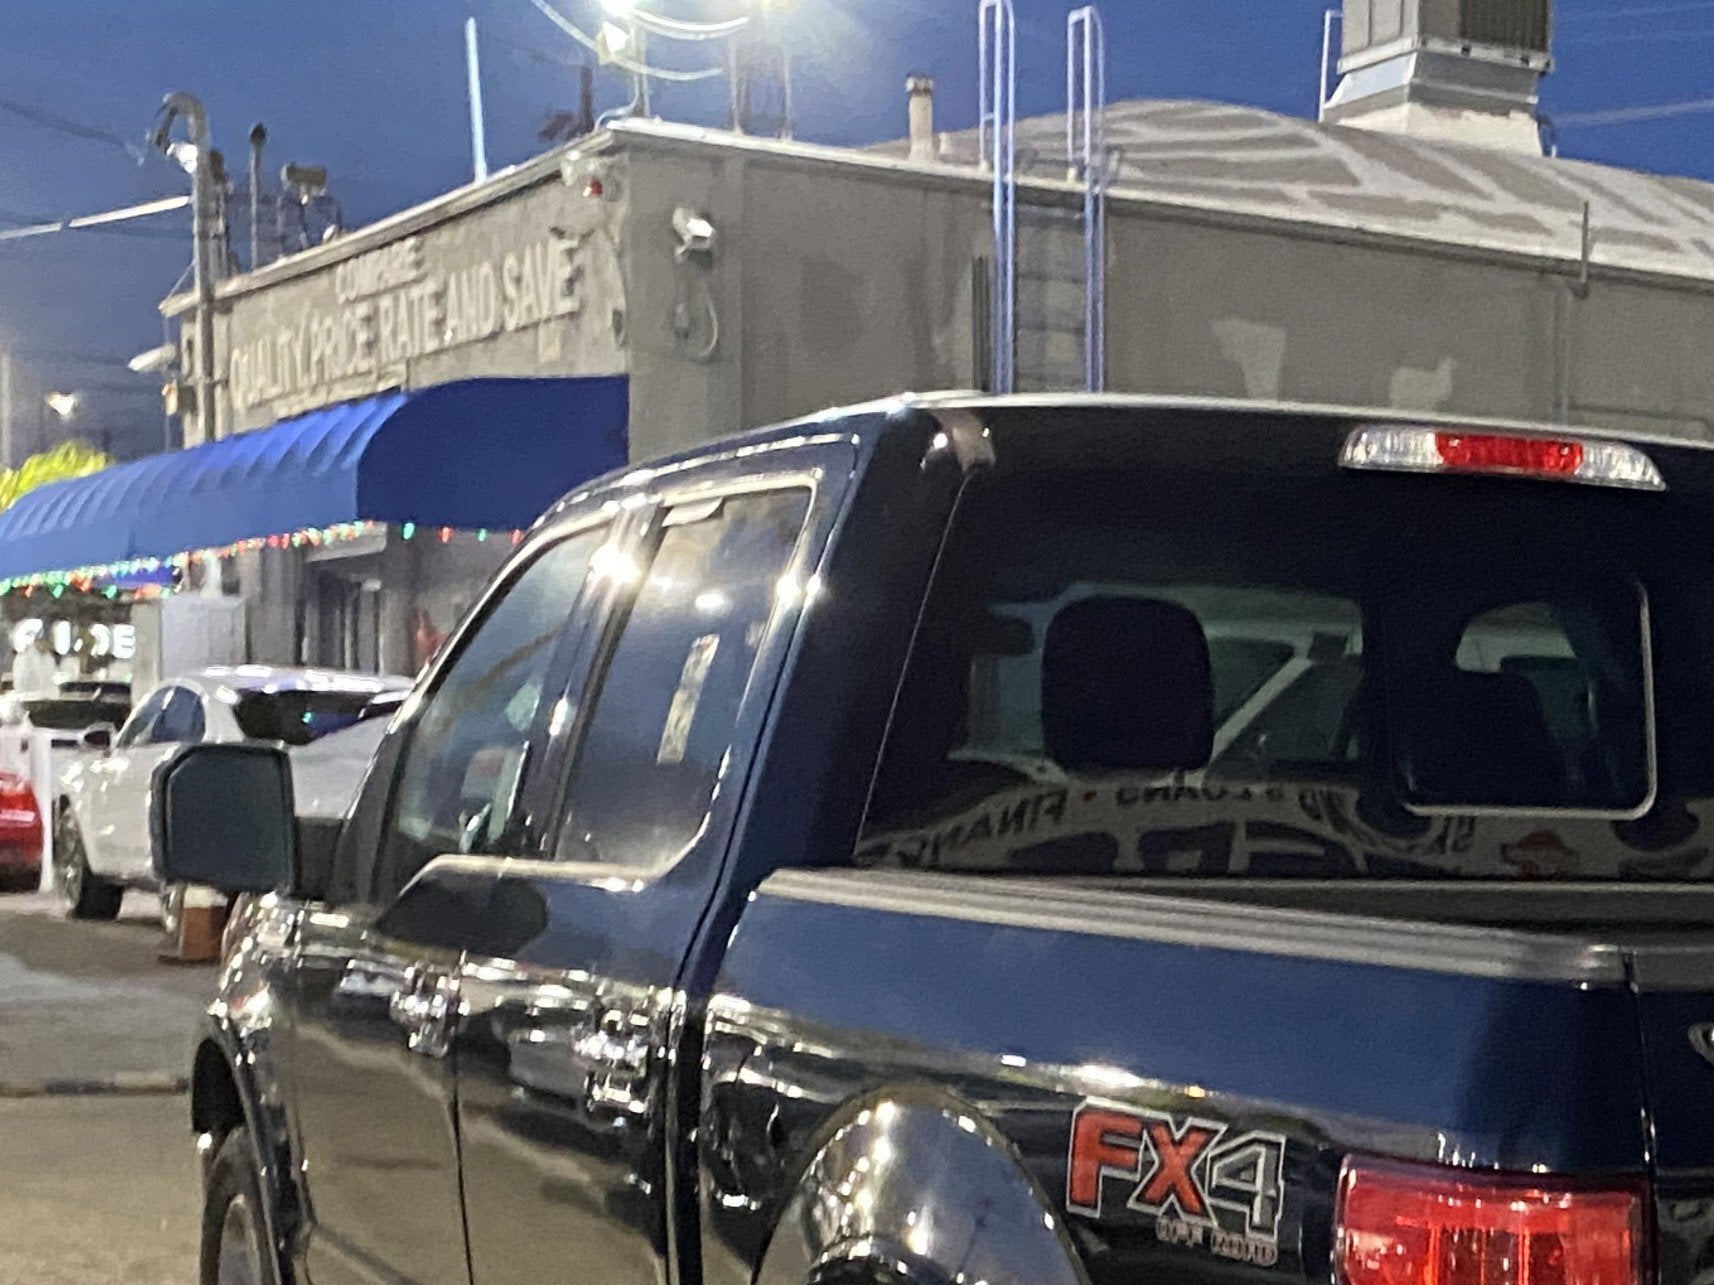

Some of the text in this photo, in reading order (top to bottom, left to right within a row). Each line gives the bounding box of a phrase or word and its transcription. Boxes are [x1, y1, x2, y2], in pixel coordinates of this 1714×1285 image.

[380, 270, 443, 364] RATE
[445, 262, 496, 345] AND
[503, 239, 580, 331] SAVE
[1066, 1095, 1286, 1240] FX4
